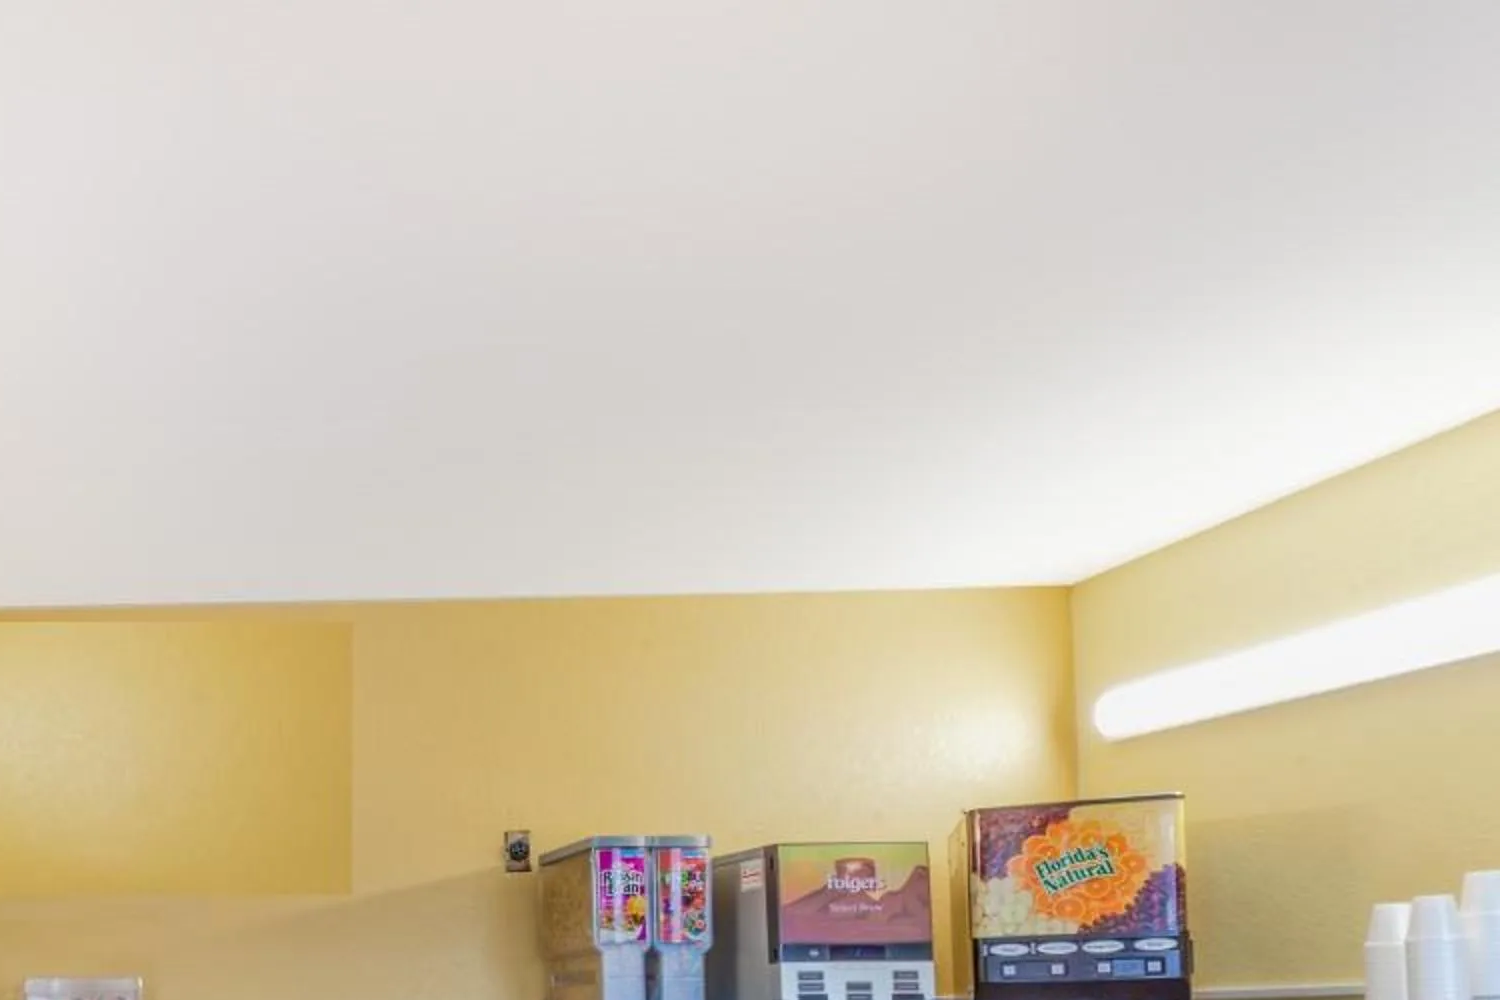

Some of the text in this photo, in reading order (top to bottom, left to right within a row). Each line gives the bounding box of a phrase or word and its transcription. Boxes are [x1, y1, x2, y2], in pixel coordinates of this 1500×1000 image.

[1034, 845, 1109, 879] Florida's
[603, 868, 644, 883] Rsin
[1043, 859, 1114, 894] Natural
[606, 882, 639, 895] Ban
